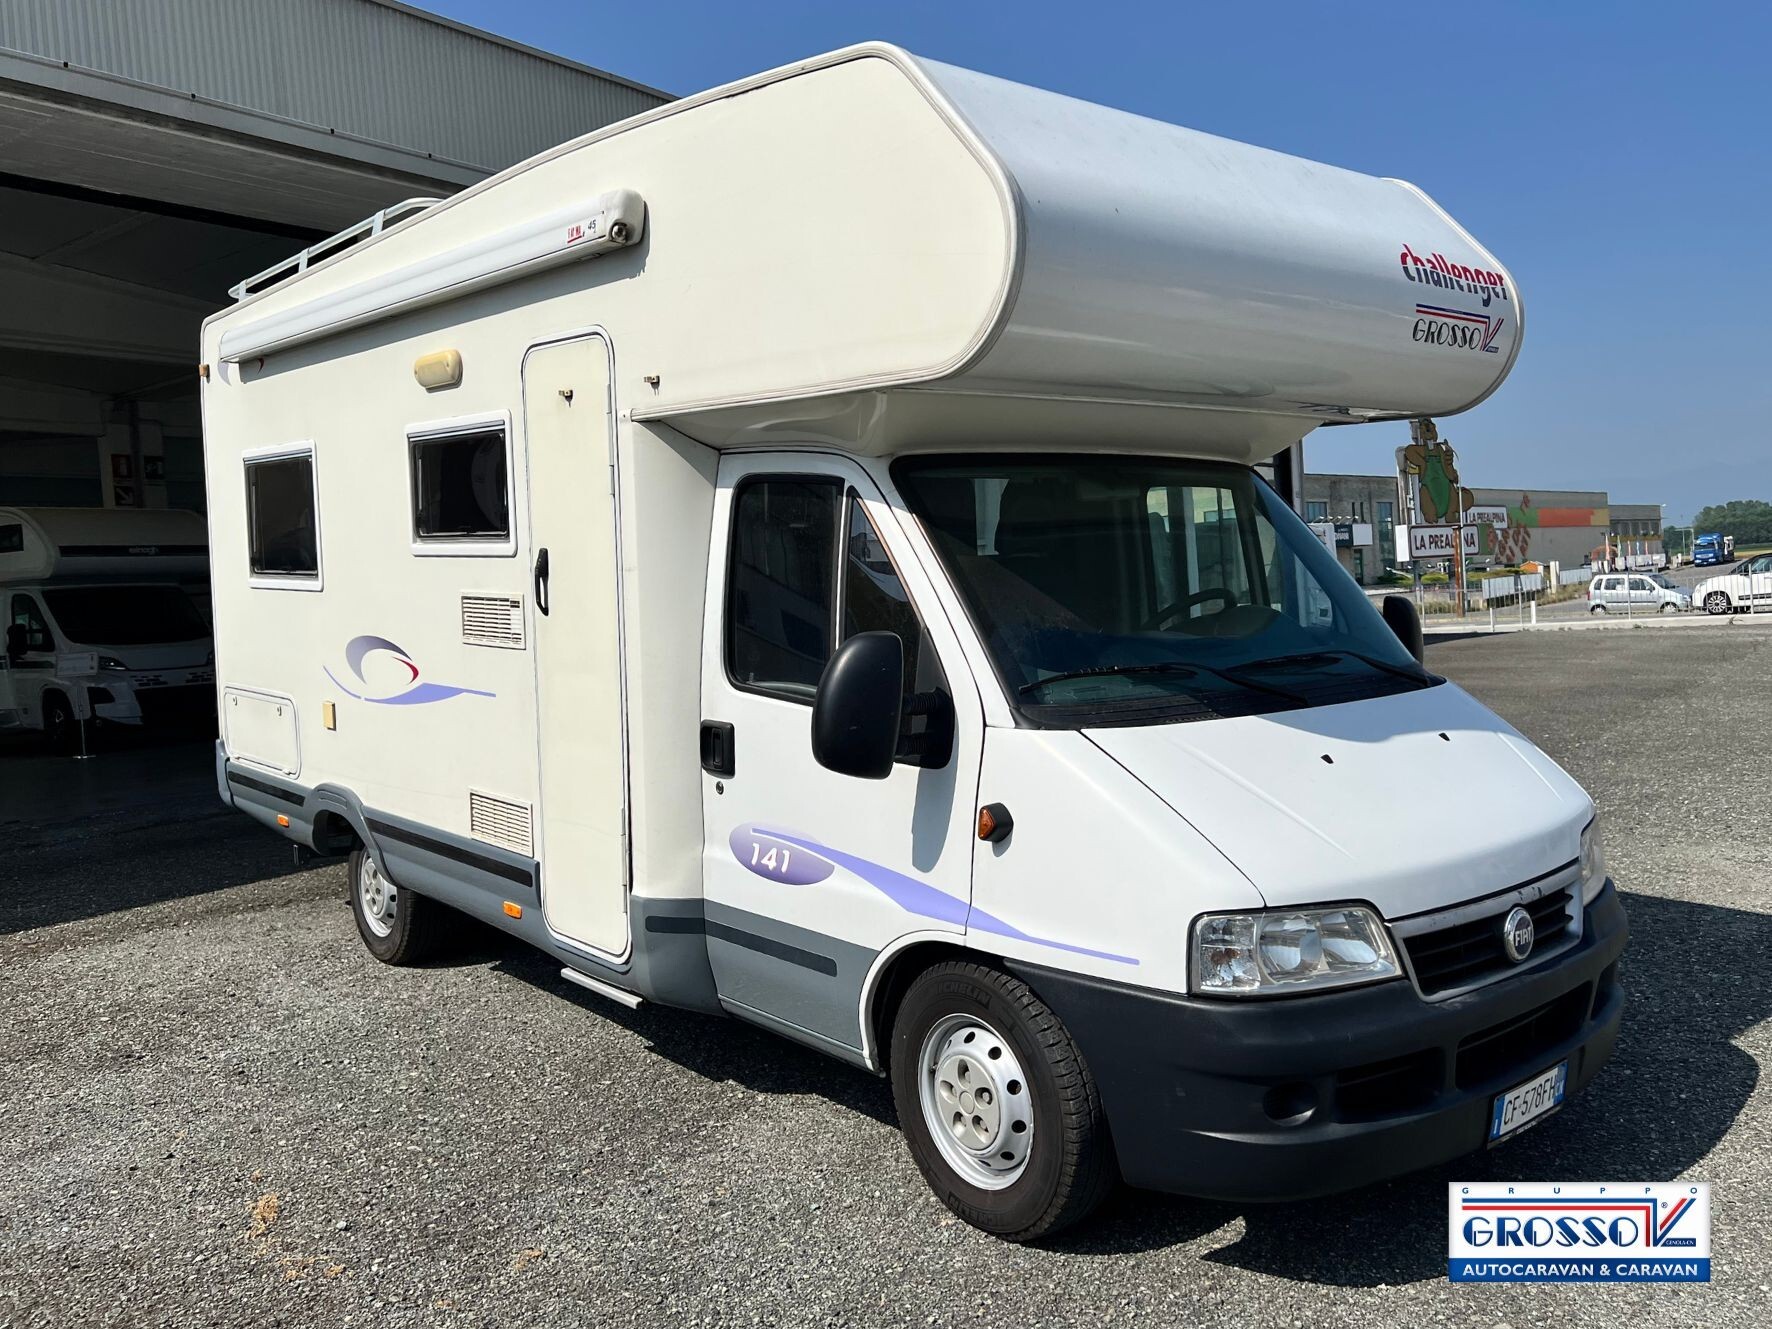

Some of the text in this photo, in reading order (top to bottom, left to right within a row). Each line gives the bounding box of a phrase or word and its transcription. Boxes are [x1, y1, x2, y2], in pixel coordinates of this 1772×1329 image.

[1415, 533, 1475, 550] LA PREALNA
[751, 842, 790, 873] 141
[1515, 926, 1532, 947] FIAT
